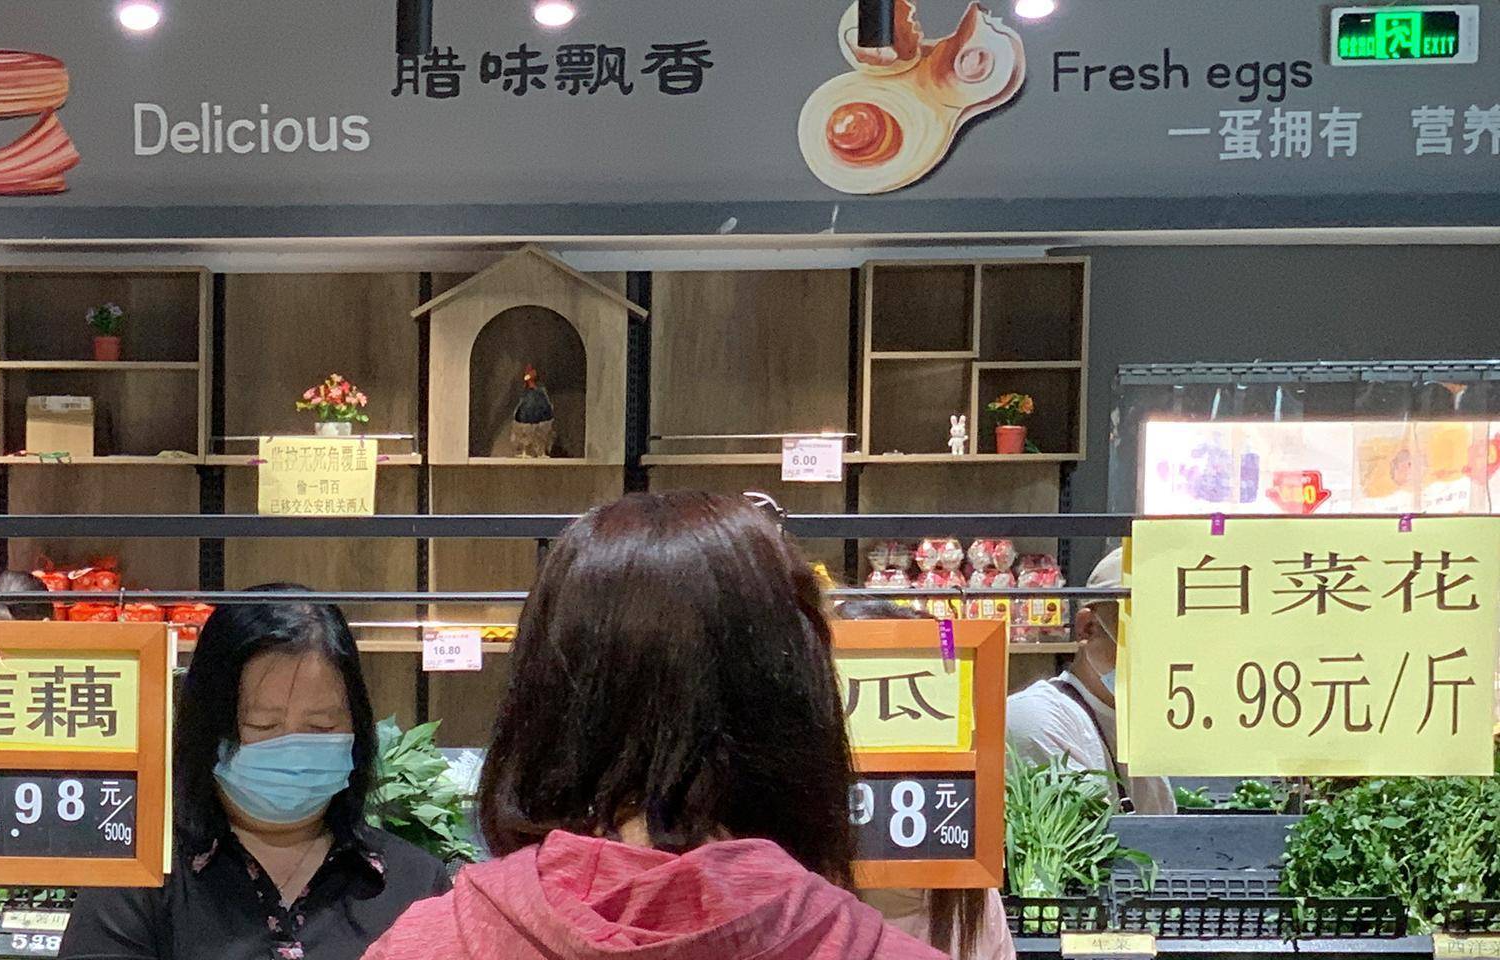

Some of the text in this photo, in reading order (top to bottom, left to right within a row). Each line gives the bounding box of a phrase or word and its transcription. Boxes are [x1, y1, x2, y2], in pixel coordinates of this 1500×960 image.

[391, 39, 714, 99] 腊味飘香
[1423, 36, 1455, 55] EXIT
[1053, 48, 1313, 103] Fresh eggs
[134, 102, 370, 156] Delicious
[1168, 104, 1500, 160] 一蛋拥有 营养
[792, 455, 817, 466] 6.00
[1176, 551, 1481, 617] 白菜花
[433, 645, 461, 656] 16.80
[1166, 647, 1476, 737] 5.98元/斤
